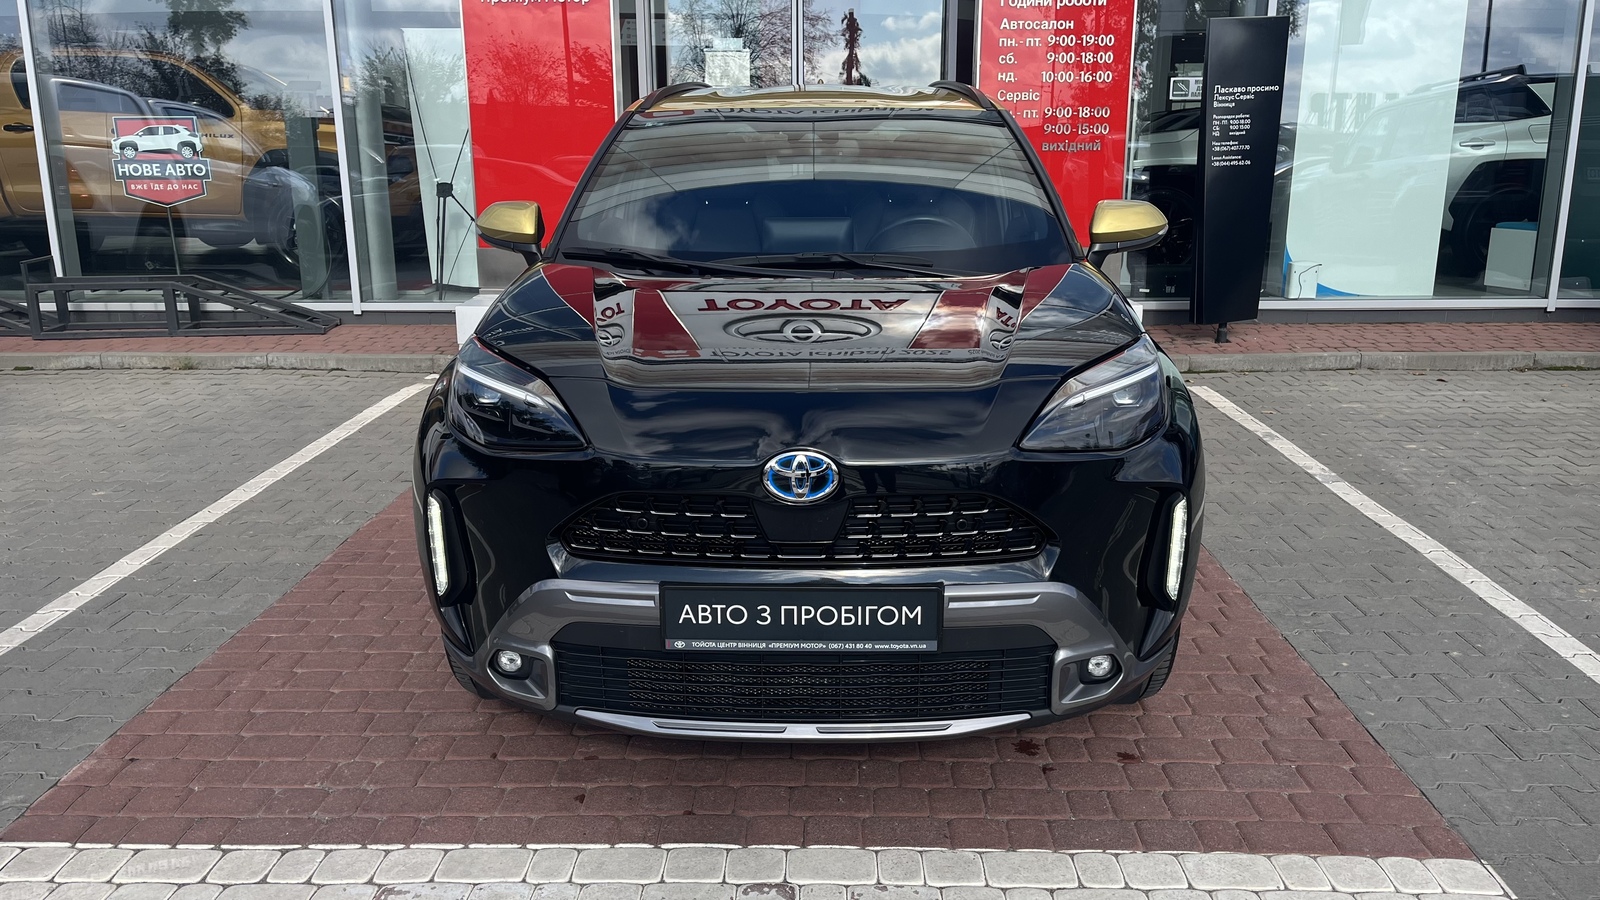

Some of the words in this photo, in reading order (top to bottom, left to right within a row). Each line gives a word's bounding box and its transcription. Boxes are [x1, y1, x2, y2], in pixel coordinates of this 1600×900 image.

[1000, 18, 1074, 30] Автосалон
[1047, 34, 1115, 47] 9:00-19:00
[998, 53, 1018, 64] сб.
[1046, 51, 1114, 64] 9:00-18:00
[997, 72, 1018, 83] нд.
[1041, 70, 1113, 83] 10:00-16:00
[997, 89, 1040, 103] Сервіс
[1214, 85, 1246, 94] Ласкаво
[1247, 85, 1280, 93] просимо
[1044, 106, 1111, 119] 9:00-18:00
[1043, 122, 1110, 135] 9:00-15:00
[1041, 139, 1101, 153] вихідний
[117, 163, 162, 177] НОВЕ
[165, 163, 206, 177] АВТО
[150, 182, 164, 191] ЇДЕ
[678, 604, 748, 625] АВТО
[755, 604, 772, 626] З
[780, 605, 922, 626] ПРОБІГОМ
[717, 641, 738, 649] ЦЕНТР
